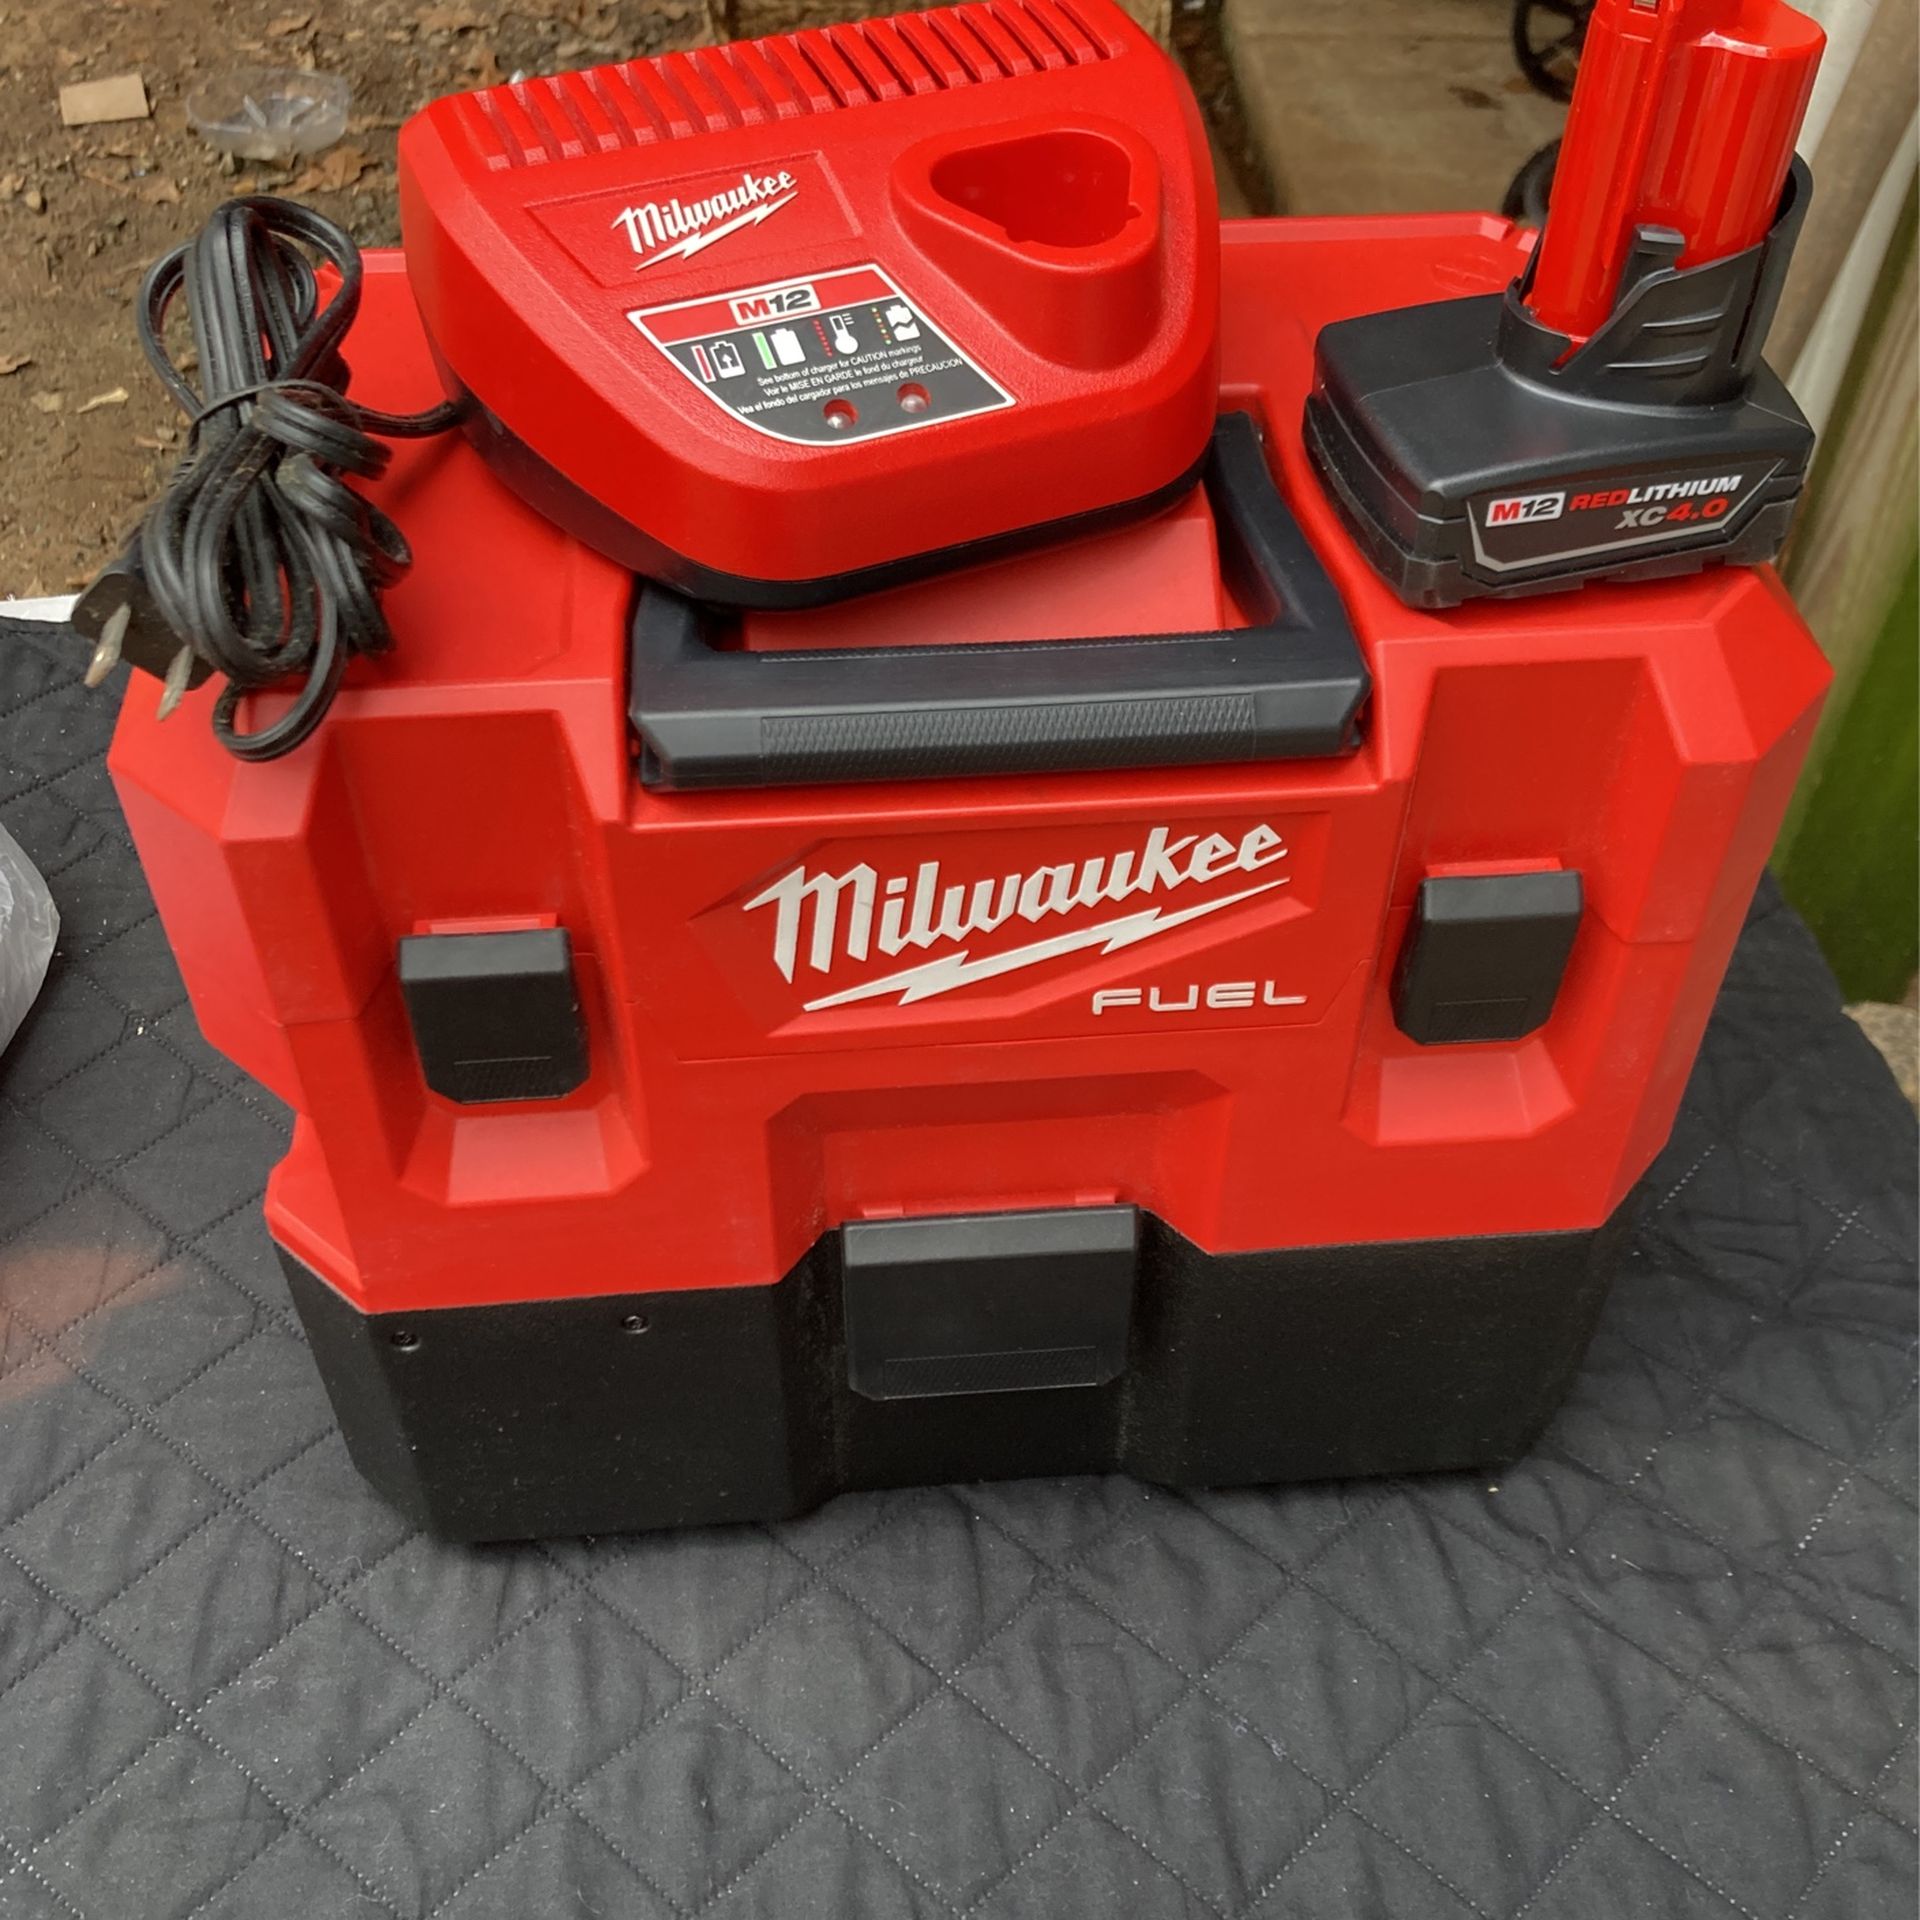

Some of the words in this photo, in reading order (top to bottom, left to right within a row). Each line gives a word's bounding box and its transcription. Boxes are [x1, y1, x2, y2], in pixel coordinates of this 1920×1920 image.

[610, 171, 797, 254] Milwaukee
[736, 289, 812, 320] M12
[757, 376, 774, 386] See
[774, 371, 801, 383] bottom
[801, 367, 810, 376] of
[810, 362, 838, 375] charger
[839, 359, 850, 368] for
[850, 351, 888, 366] CAUTION
[888, 344, 922, 358] markings
[763, 387, 780, 397] Voir
[780, 384, 789, 393] le
[789, 379, 811, 391] MISE
[811, 376, 824, 387] EN
[824, 369, 854, 383] GARDE
[854, 368, 862, 377] le
[862, 364, 880, 375] fond
[881, 362, 891, 371] du
[891, 355, 923, 368] chargeur
[738, 405, 755, 415] Vea
[754, 402, 763, 411] el
[762, 397, 786, 410] fondo
[786, 393, 798, 404] del
[799, 387, 832, 401] cargador
[832, 382, 851, 395] para
[849, 381, 863, 390] los
[863, 373, 899, 387] mensajes
[899, 370, 909, 379] de
[1491, 497, 1561, 523] M12
[1568, 474, 1743, 512] REDLITHIUM
[743, 823, 1289, 984] Milwaukee
[1092, 980, 1308, 1015] FUEL
